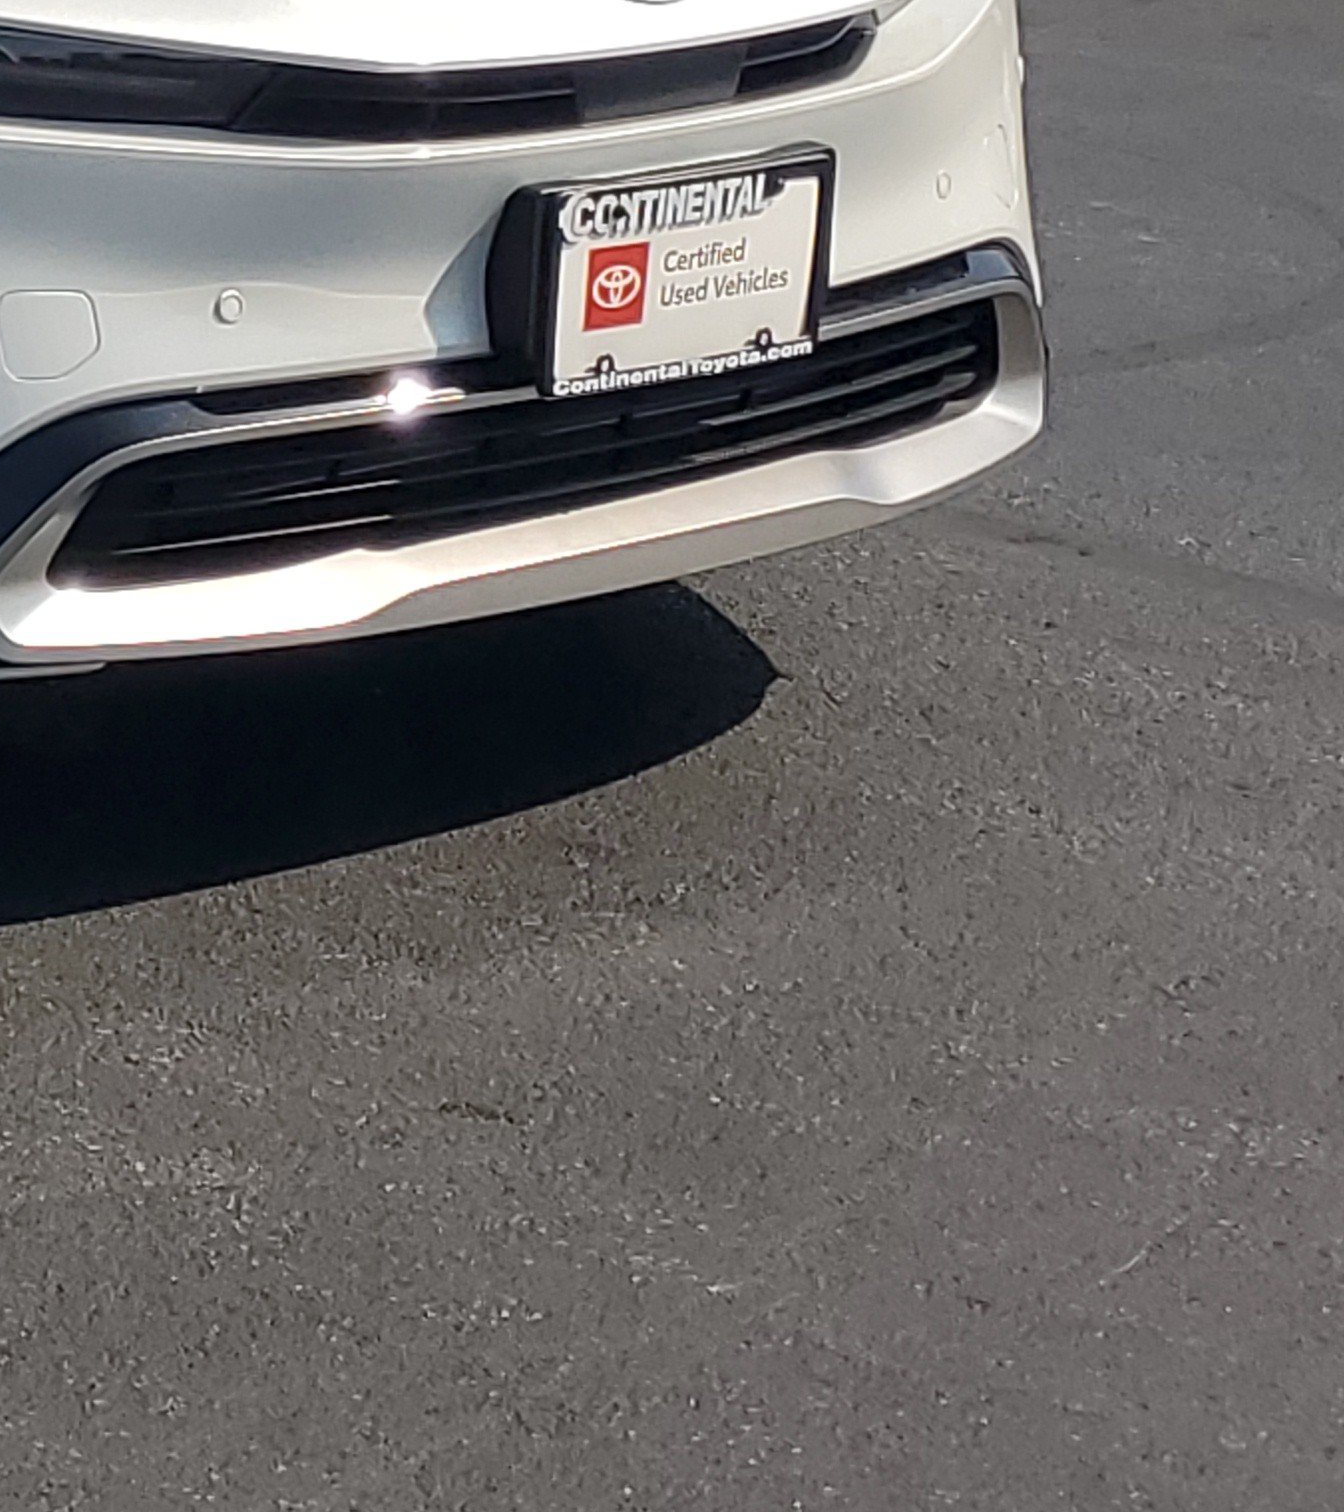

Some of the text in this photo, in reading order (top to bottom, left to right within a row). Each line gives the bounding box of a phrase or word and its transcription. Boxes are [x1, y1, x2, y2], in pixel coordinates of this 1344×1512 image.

[568, 172, 769, 238] CONTINENTAL
[663, 236, 747, 273] Certified
[660, 266, 789, 307] Used Vehicles
